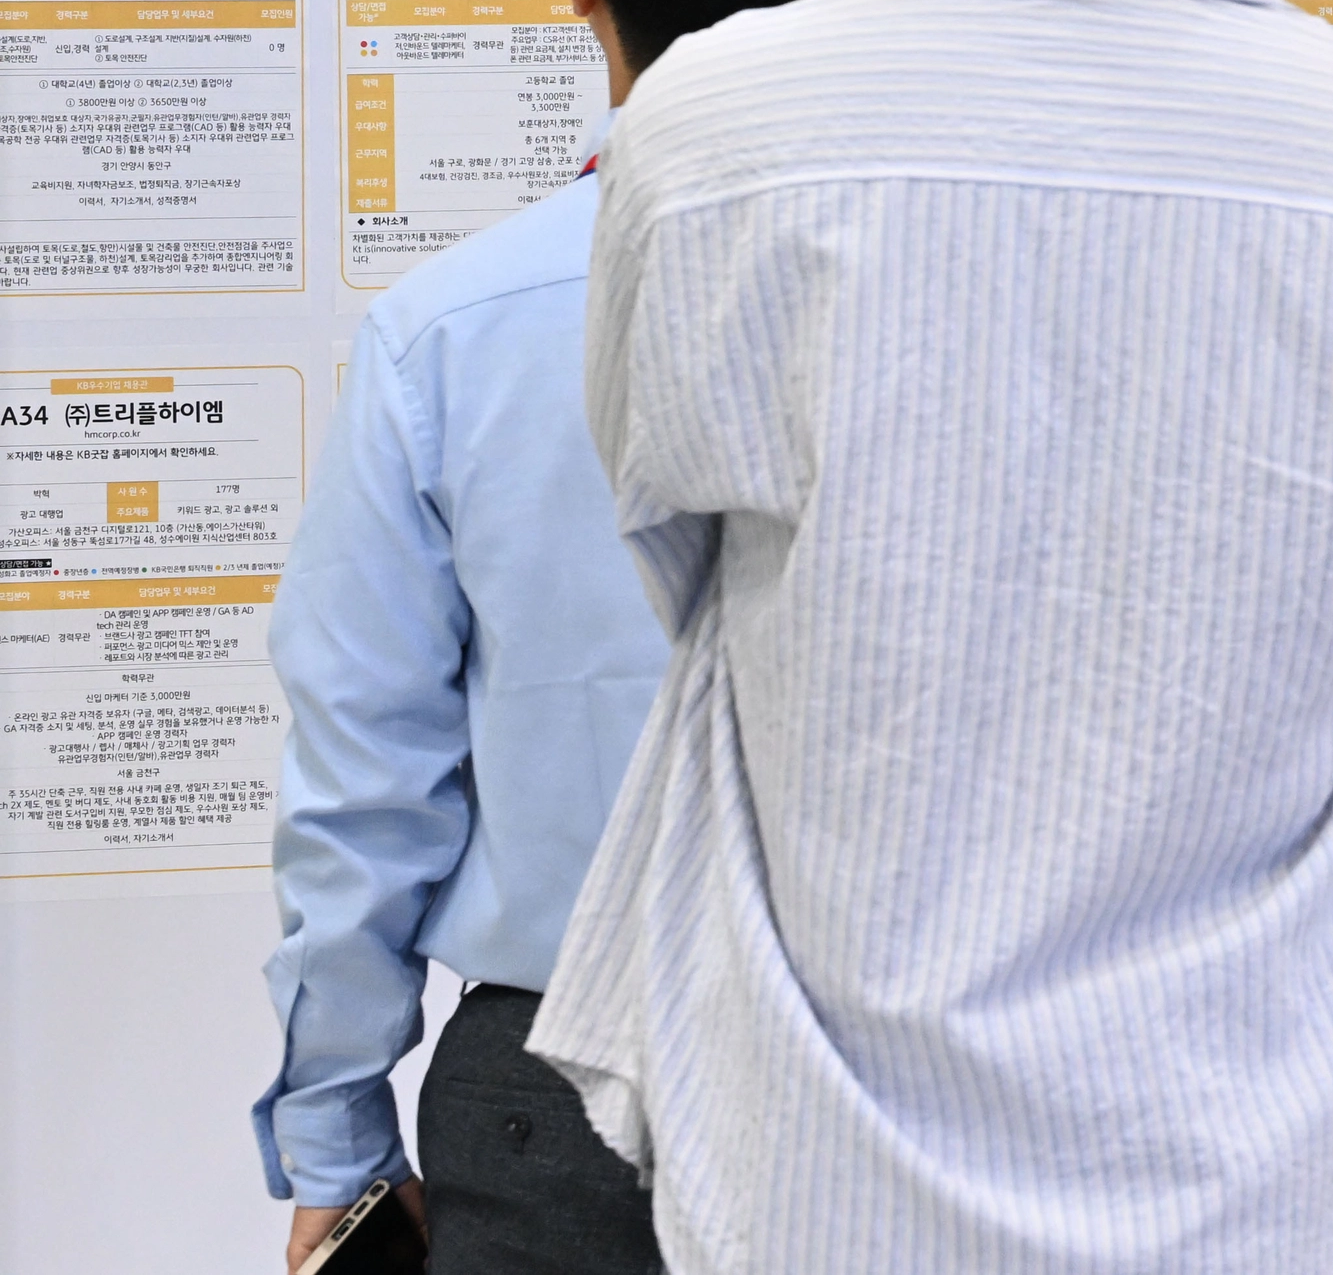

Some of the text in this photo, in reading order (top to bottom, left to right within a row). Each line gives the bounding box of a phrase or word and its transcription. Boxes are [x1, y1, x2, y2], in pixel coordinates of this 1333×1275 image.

[1, 406, 48, 425] A34
[84, 429, 141, 440] hmcorp.co.kr
[216, 484, 240, 494] 177명
[121, 673, 155, 684] 학력무관
[103, 832, 174, 845] 이력서, 자기소개서
